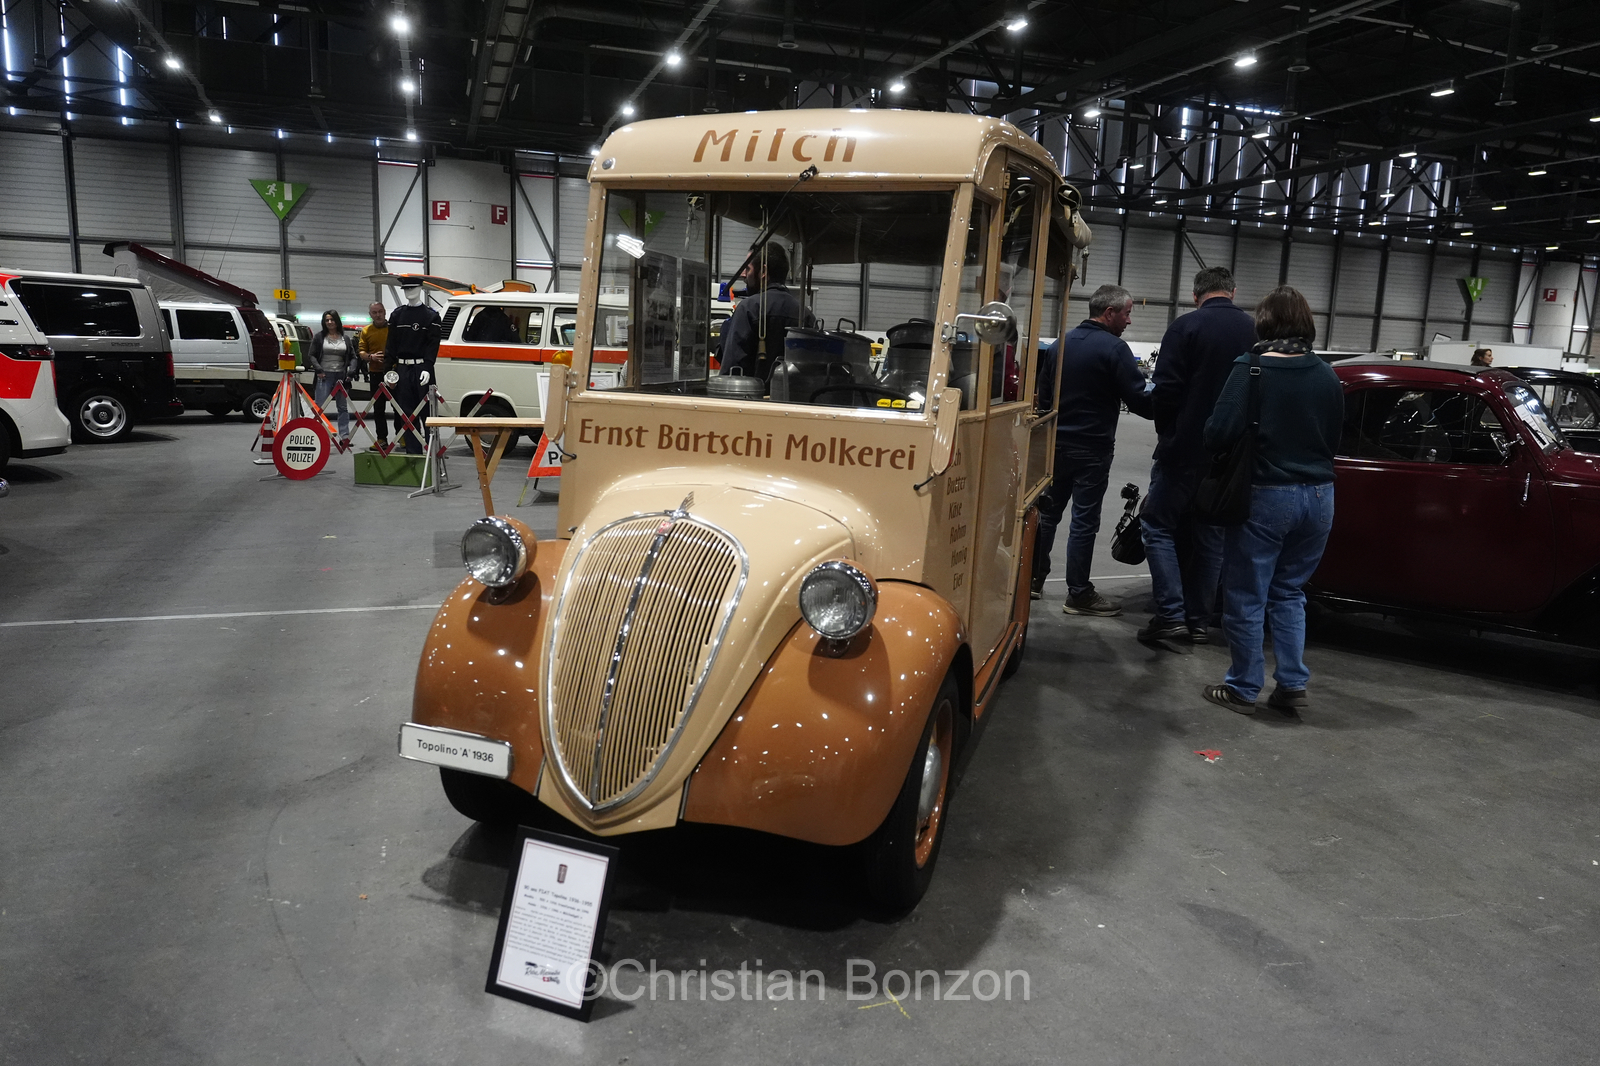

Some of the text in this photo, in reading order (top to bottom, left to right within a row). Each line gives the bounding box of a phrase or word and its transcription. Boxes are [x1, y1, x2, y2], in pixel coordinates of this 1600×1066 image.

[692, 127, 858, 163] Milch
[437, 202, 446, 216] F
[496, 206, 505, 220] F
[279, 289, 291, 299] 16
[1547, 289, 1555, 299] F
[289, 434, 315, 447] POLICE
[578, 418, 917, 471] Ernst Bärtschi Molkerei
[286, 451, 314, 463] POLIZEI
[946, 475, 967, 496] Butter
[948, 501, 964, 520] Käse
[949, 523, 967, 545] Rahm
[950, 546, 968, 568] Honig
[952, 572, 965, 591] Eier
[416, 738, 458, 756] Topolino
[472, 750, 494, 763] 1936
